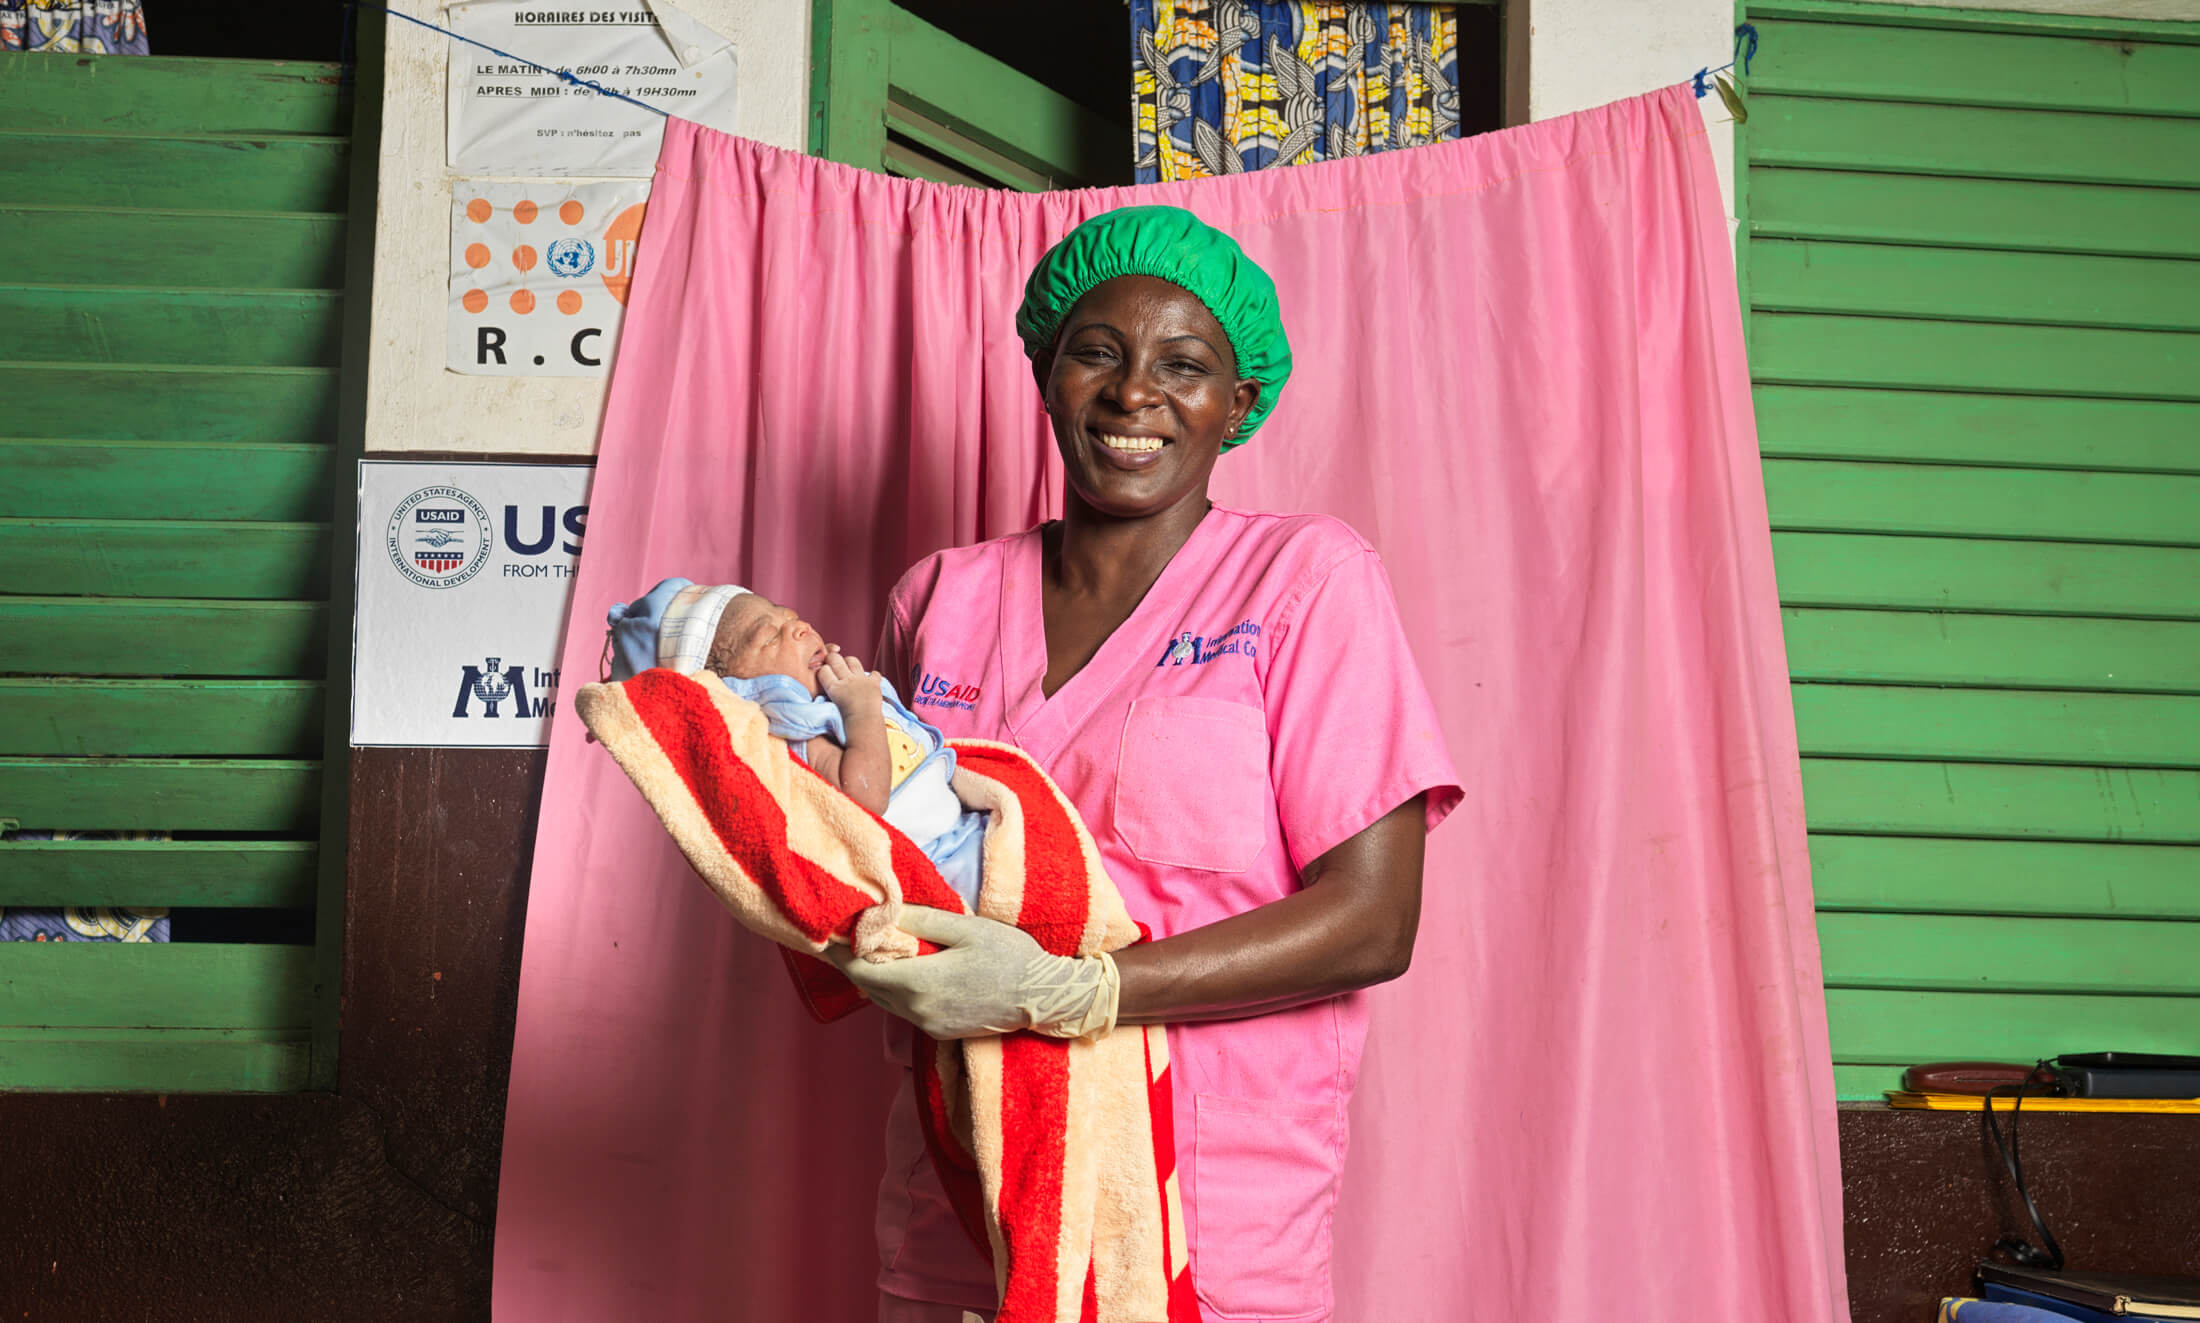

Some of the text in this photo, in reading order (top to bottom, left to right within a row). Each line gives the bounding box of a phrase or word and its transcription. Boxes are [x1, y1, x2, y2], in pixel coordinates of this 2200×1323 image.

[514, 11, 659, 24] HORAIRES DES VISIT
[476, 65, 495, 75] LE
[498, 65, 541, 75] MATIN
[576, 65, 608, 75] 6h00
[612, 65, 621, 75] à
[625, 65, 677, 75] 7h30mn
[476, 86, 522, 96] APRES
[530, 86, 560, 96] MIDI
[573, 86, 590, 96] de
[635, 87, 697, 97] 19H30mn
[536, 129, 558, 137] SVP
[623, 130, 642, 138] pas
[393, 488, 488, 522] UNITED STATES AGENCY
[420, 511, 460, 521] USAID
[504, 505, 589, 556] US
[389, 537, 490, 587] INTERNATIONAL DEVELOPMENT
[503, 564, 580, 578] FROM TH
[921, 673, 981, 702] USAID
